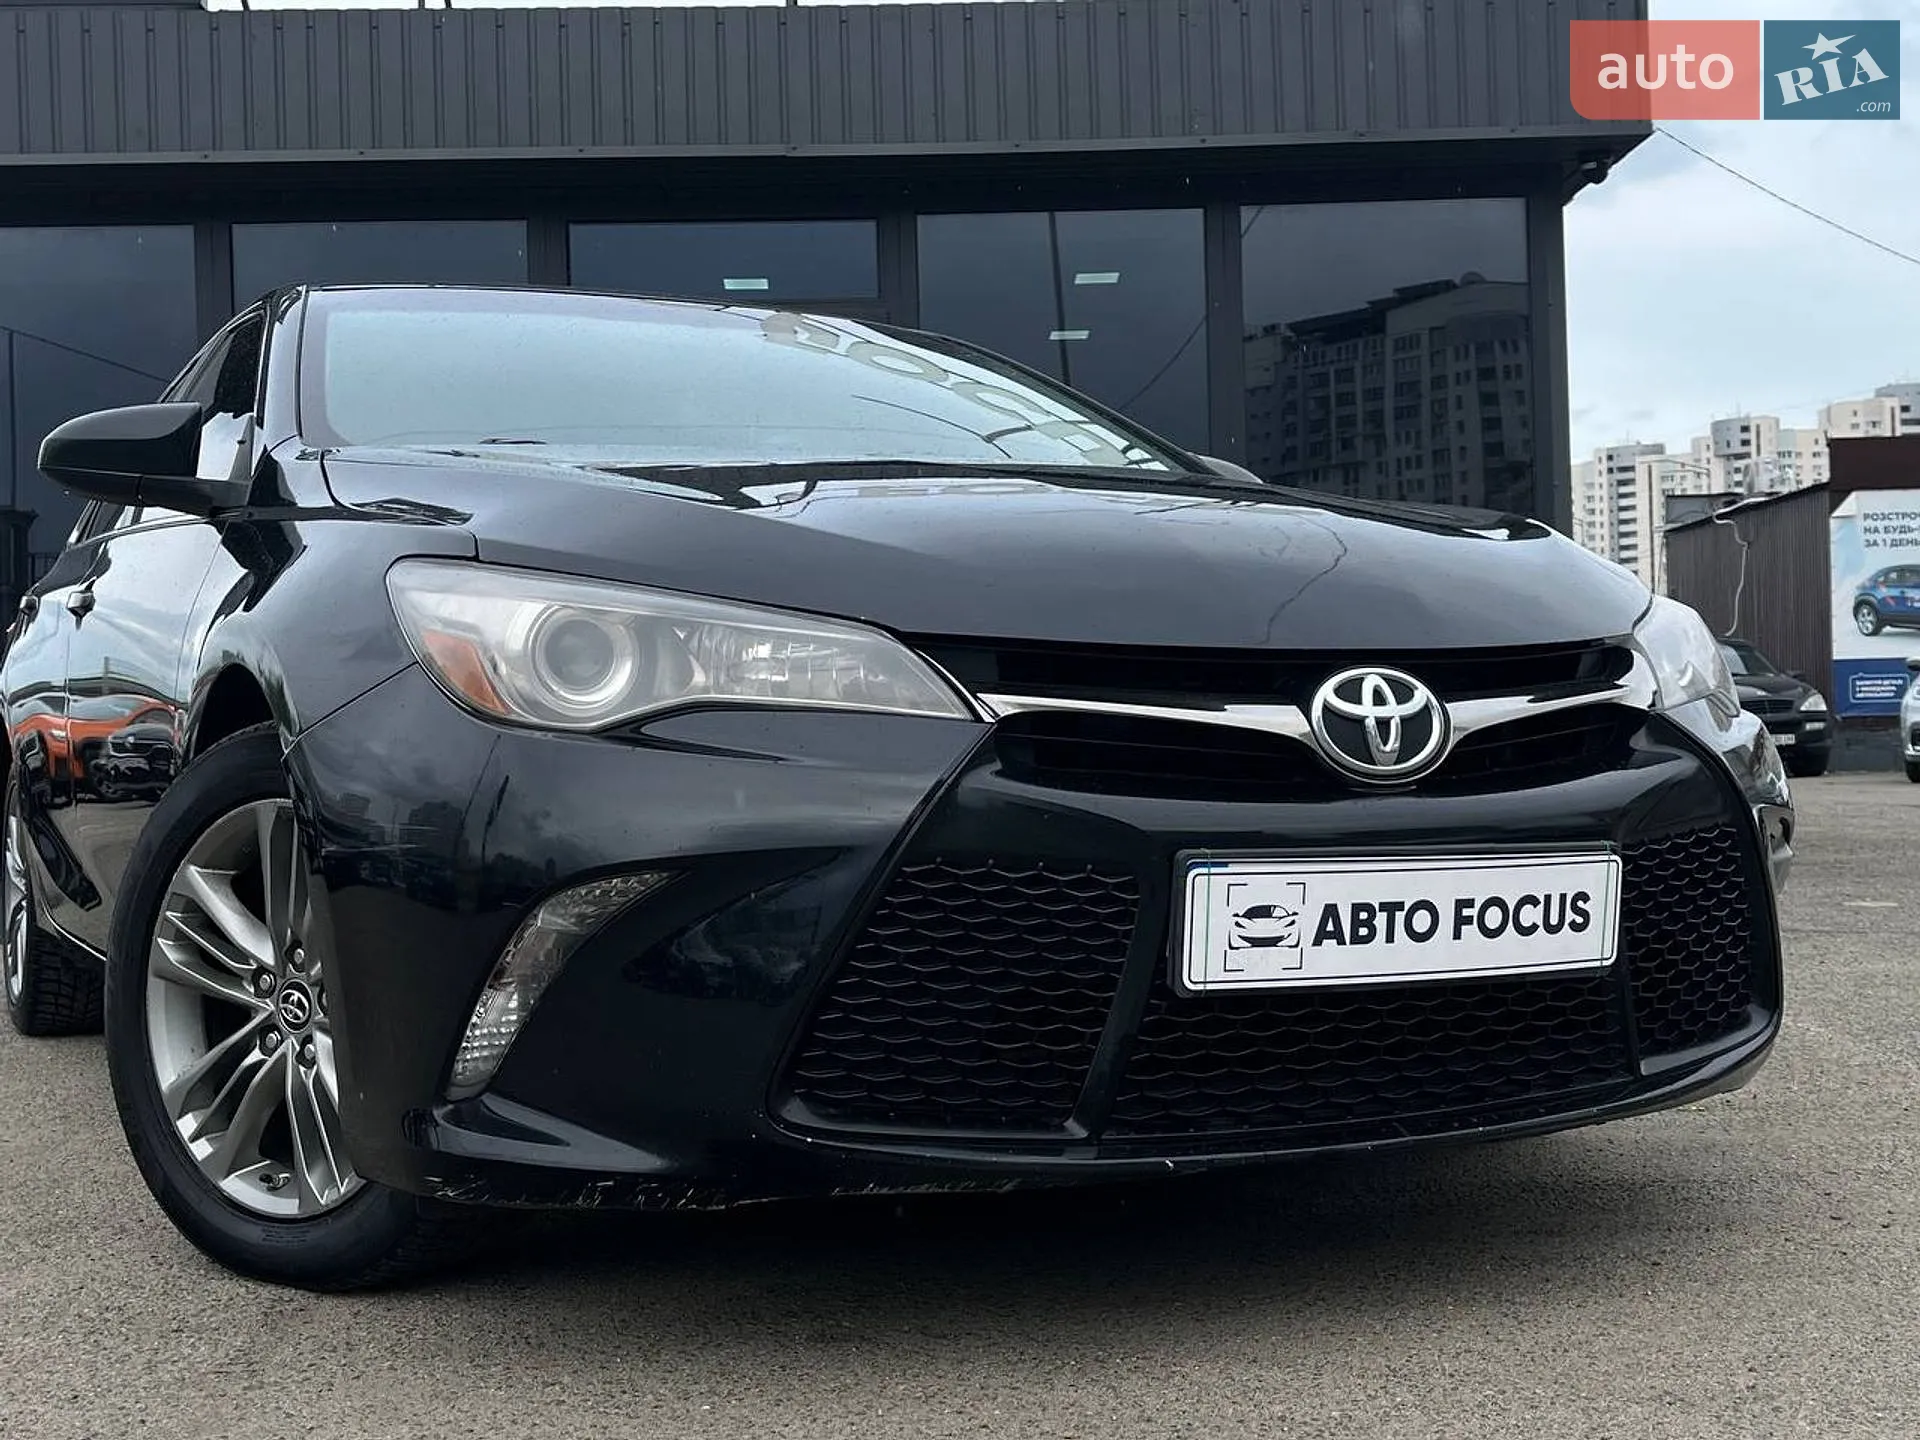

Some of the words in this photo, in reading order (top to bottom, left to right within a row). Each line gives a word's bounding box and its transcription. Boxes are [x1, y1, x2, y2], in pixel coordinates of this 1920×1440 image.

[1863, 511, 1920, 522] РОЗСТРО
[1863, 525, 1881, 535] НА
[1884, 523, 1920, 535] БУДЬ-
[1864, 538, 1880, 548] ЗА
[1882, 538, 1887, 547] 1
[1311, 898, 1441, 948] АВТО
[1452, 890, 1591, 941] FOCUS
